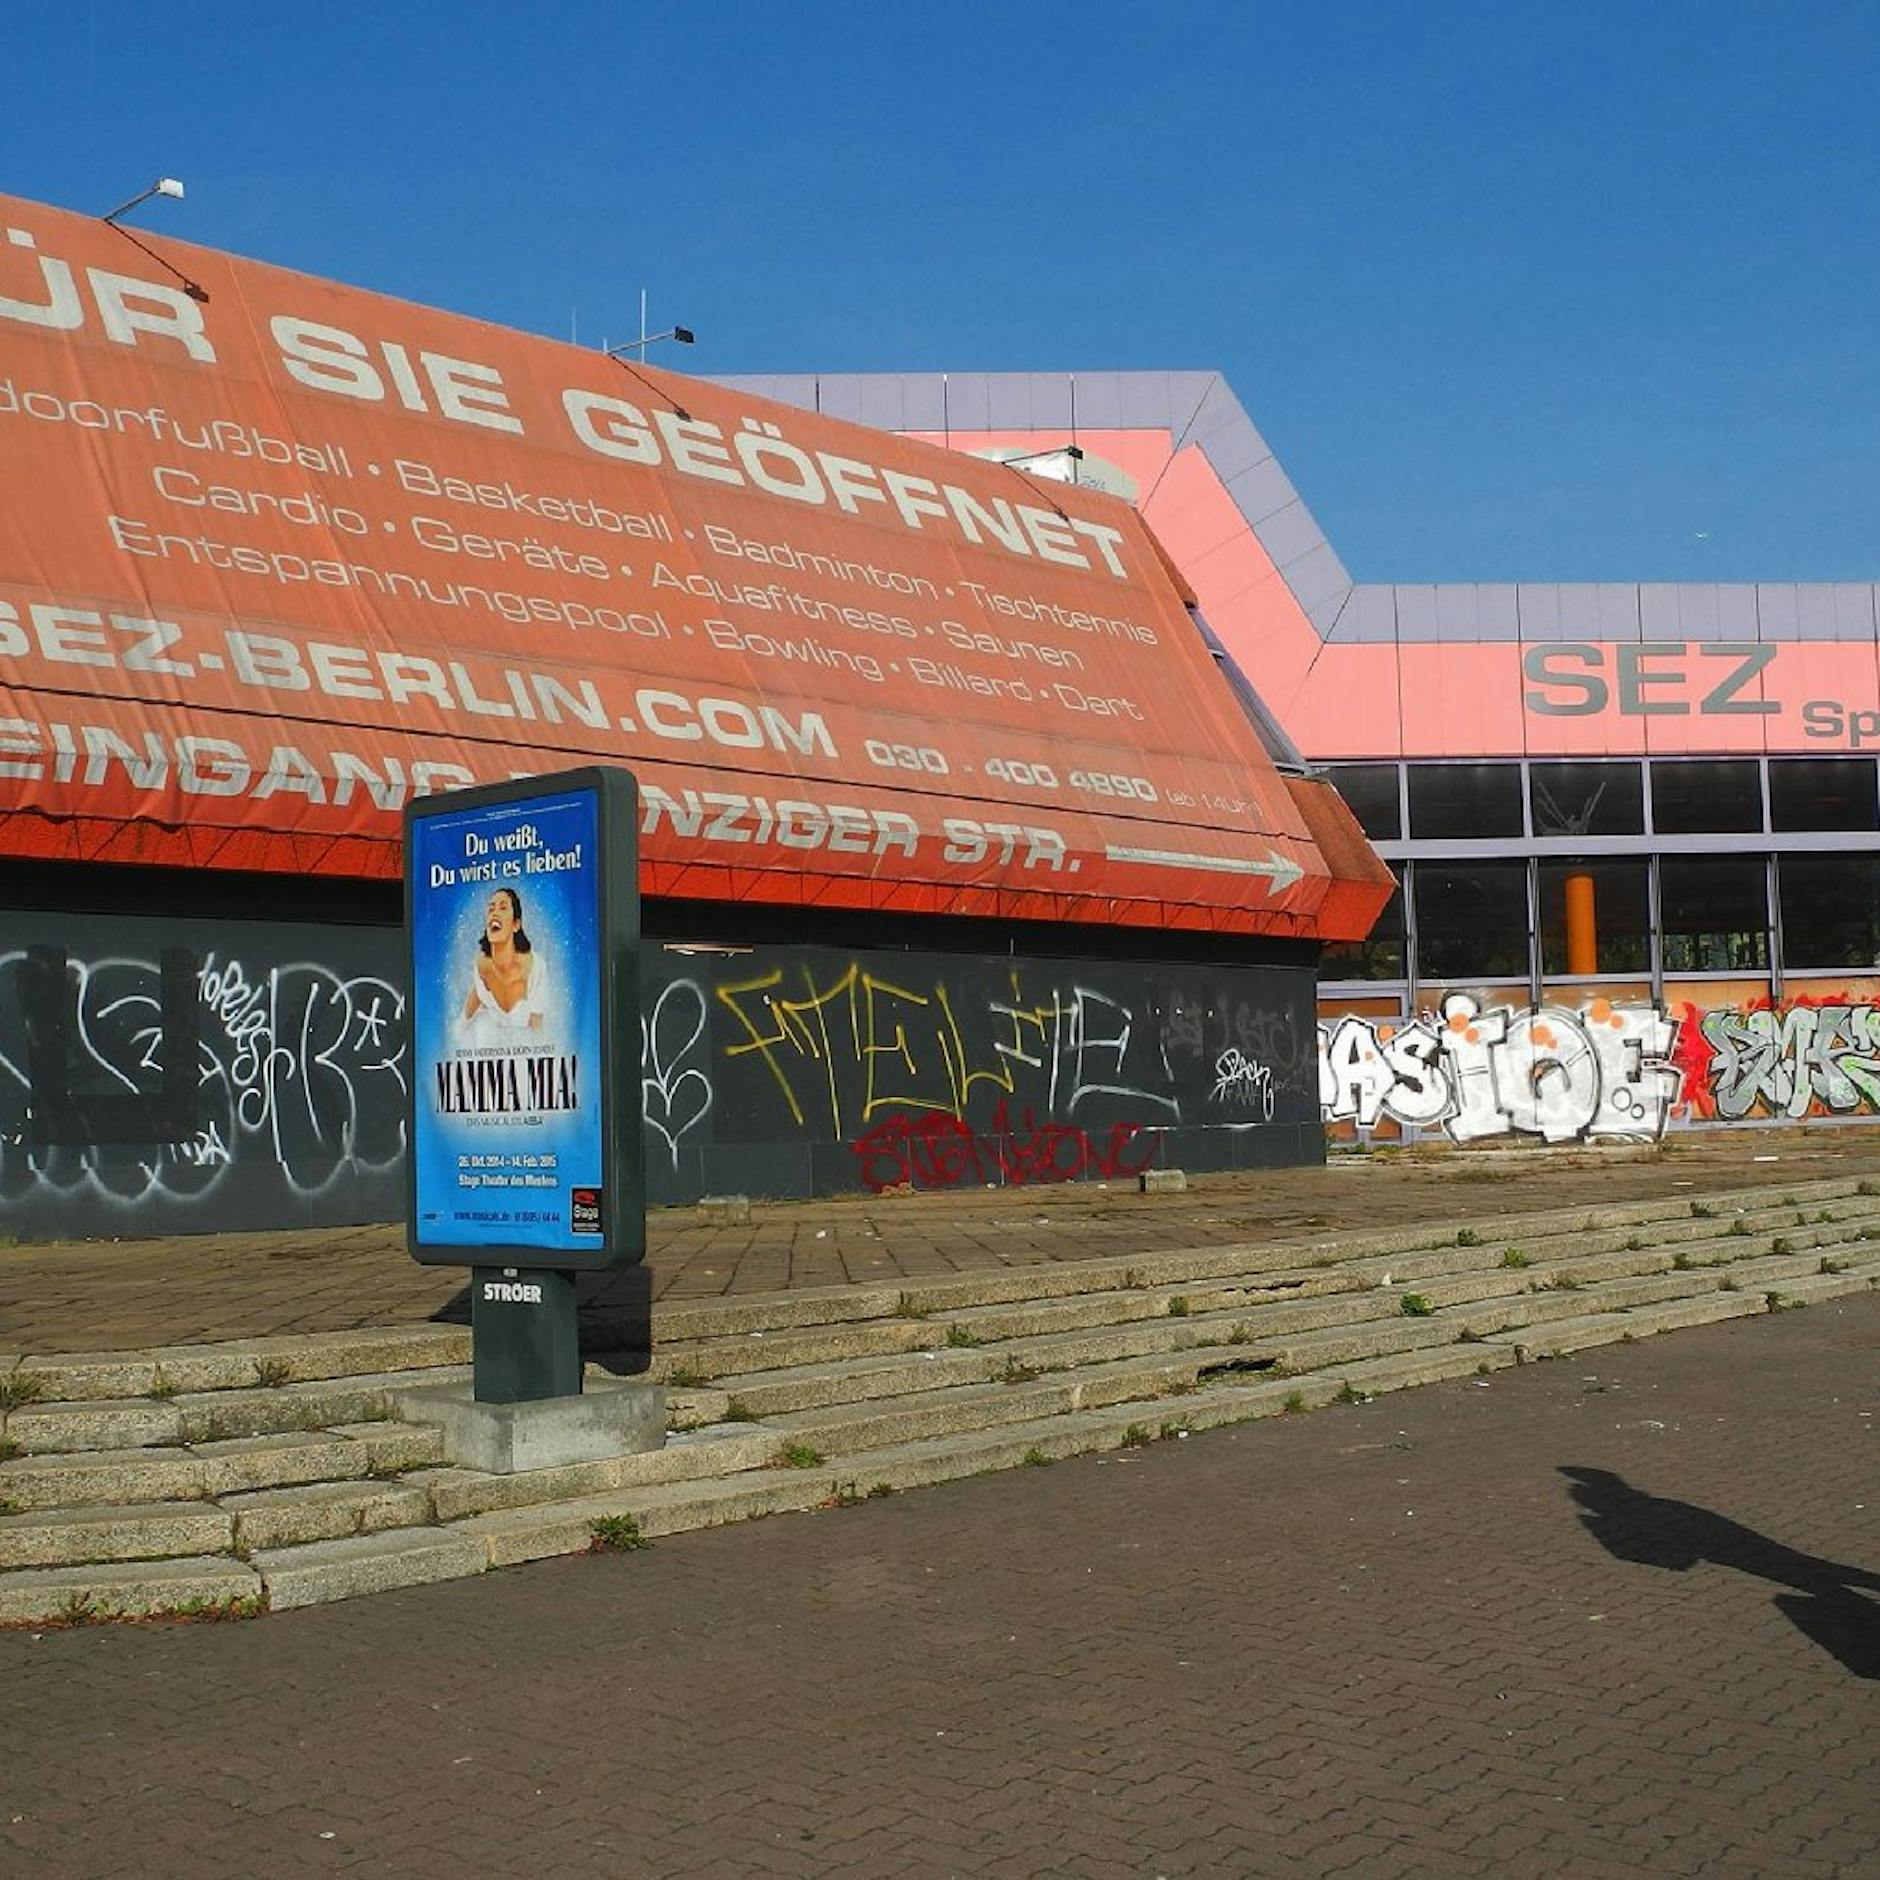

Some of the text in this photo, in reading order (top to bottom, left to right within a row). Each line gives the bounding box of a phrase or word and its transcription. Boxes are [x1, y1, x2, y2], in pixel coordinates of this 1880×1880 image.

[270, 316, 524, 435] SIE
[562, 388, 1127, 580] GEÖFFNET
[153, 466, 1085, 671] Cardio Geräte Aquafitness Saunen
[394, 459, 673, 543] Basketball
[704, 524, 939, 600] Badminton
[959, 581, 1158, 645] Tischtennis
[107, 515, 1144, 721] Entspannungspool Bowling Billard Dart
[1524, 643, 1880, 748] SEZ Sp
[864, 739, 949, 774] 030
[984, 756, 1060, 788] 400
[1069, 769, 1158, 801] 4890
[430, 845, 583, 888] Du wirst es lieben!
[465, 824, 544, 857] Du weißt,
[943, 817, 1081, 873] STR.
[435, 1055, 576, 1113] MAMMA MIA!
[573, 1204, 600, 1220] Stage
[484, 1282, 542, 1304] STRÖER
